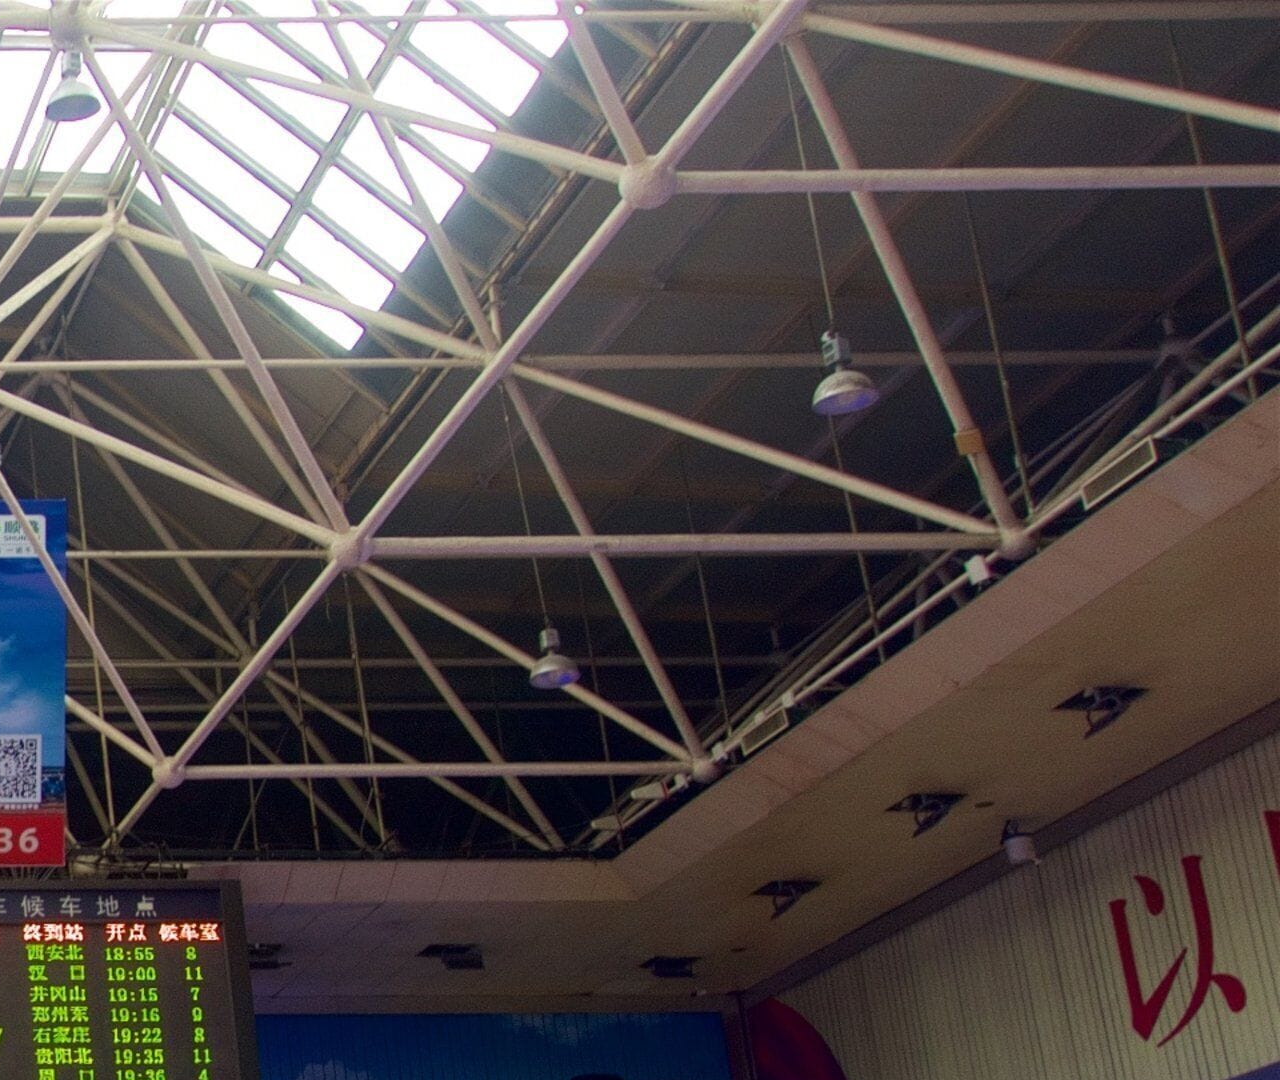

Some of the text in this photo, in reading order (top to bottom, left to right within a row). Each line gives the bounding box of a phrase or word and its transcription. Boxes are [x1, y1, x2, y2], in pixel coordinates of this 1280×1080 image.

[23, 924, 84, 943] 终到站
[106, 924, 147, 943] 开点
[159, 924, 220, 943] 候车室
[32, 1025, 92, 1044] 石家庄
[112, 1027, 163, 1045] 19:22
[193, 1026, 206, 1044] 8
[34, 1046, 94, 1065] 贵阳北
[114, 1048, 165, 1065] 19:35
[193, 1048, 212, 1064] 11
